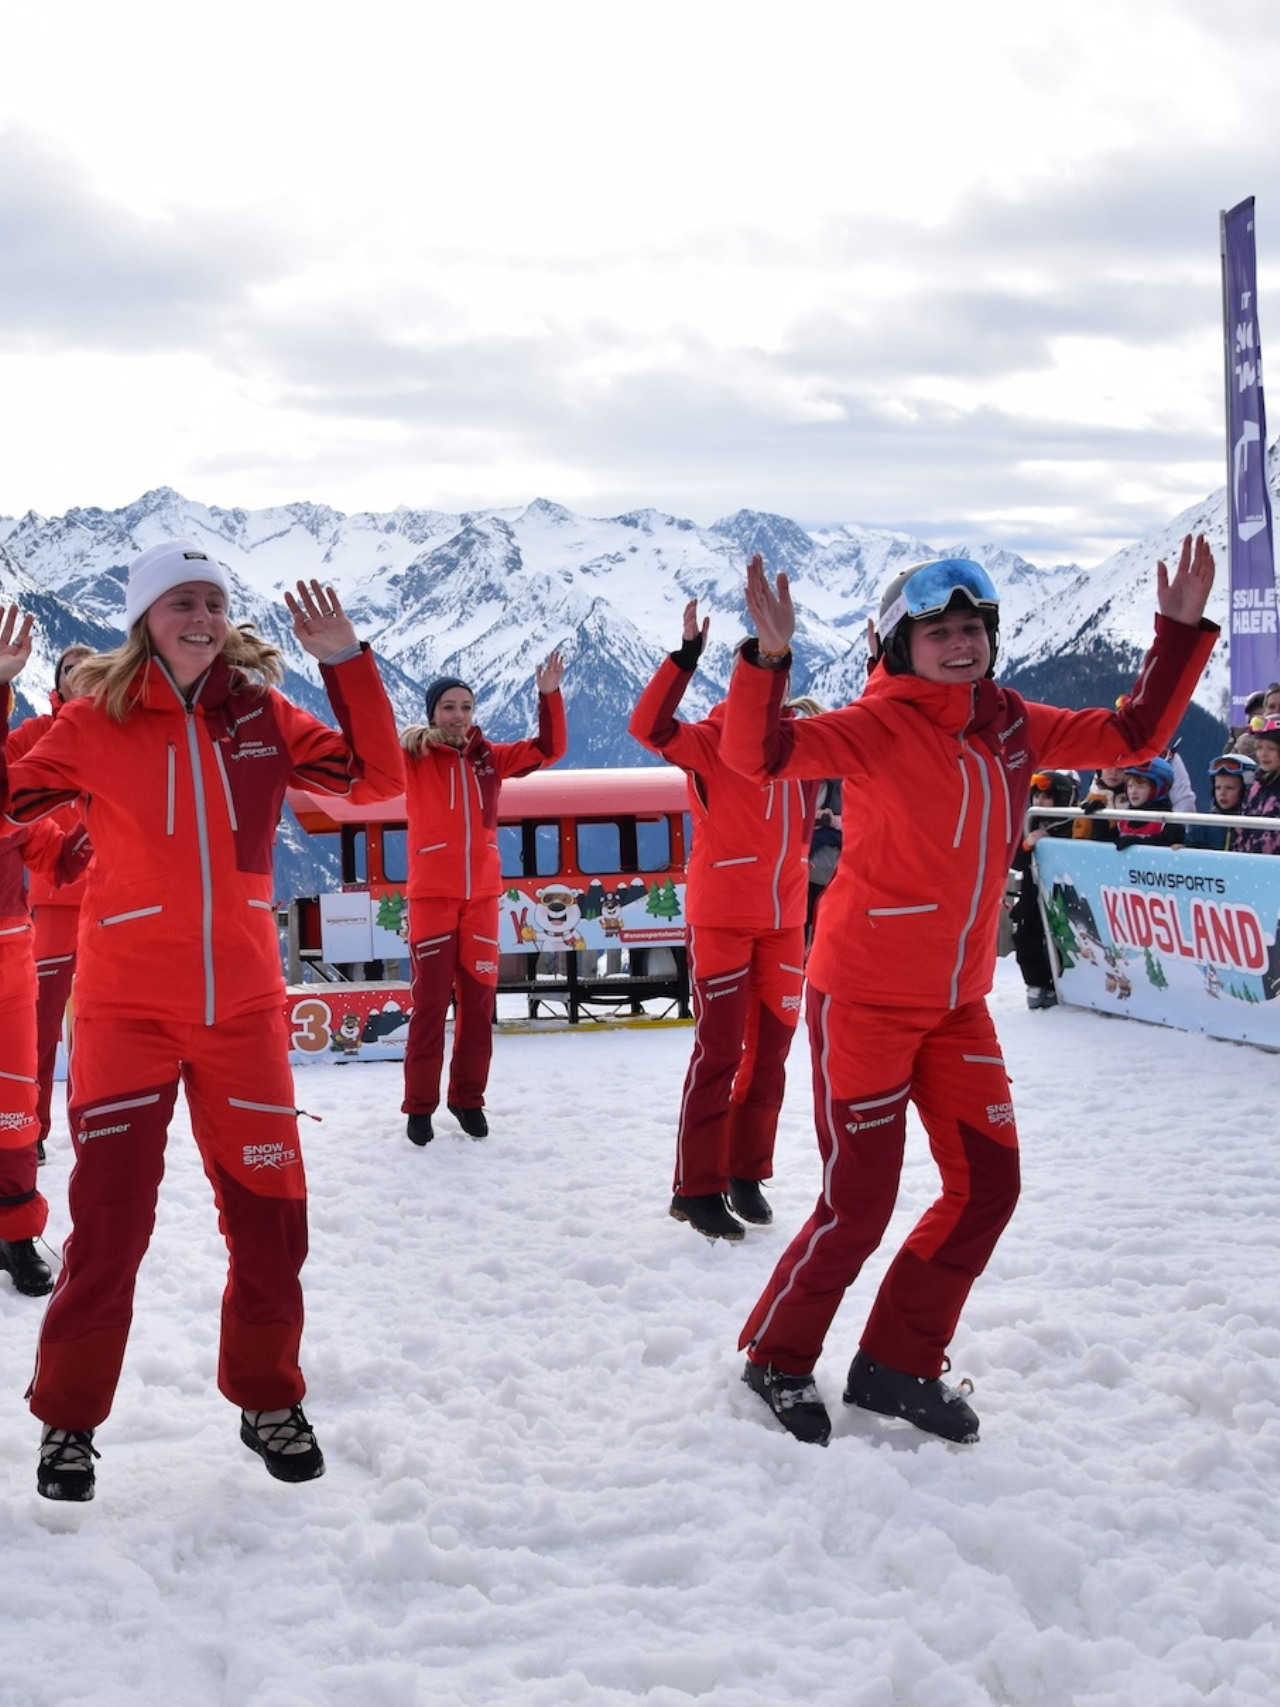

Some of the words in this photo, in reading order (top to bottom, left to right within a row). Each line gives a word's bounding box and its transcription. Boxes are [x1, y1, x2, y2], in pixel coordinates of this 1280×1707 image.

[1129, 869, 1226, 894] SNOWSPORTS
[1103, 890, 1265, 969] KIDSLAND
[294, 1003, 330, 1053] 3
[858, 1113, 896, 1130] ziener
[89, 1123, 130, 1140] ziener
[243, 1142, 283, 1155] SNOW
[243, 1149, 295, 1165] SPORTS
